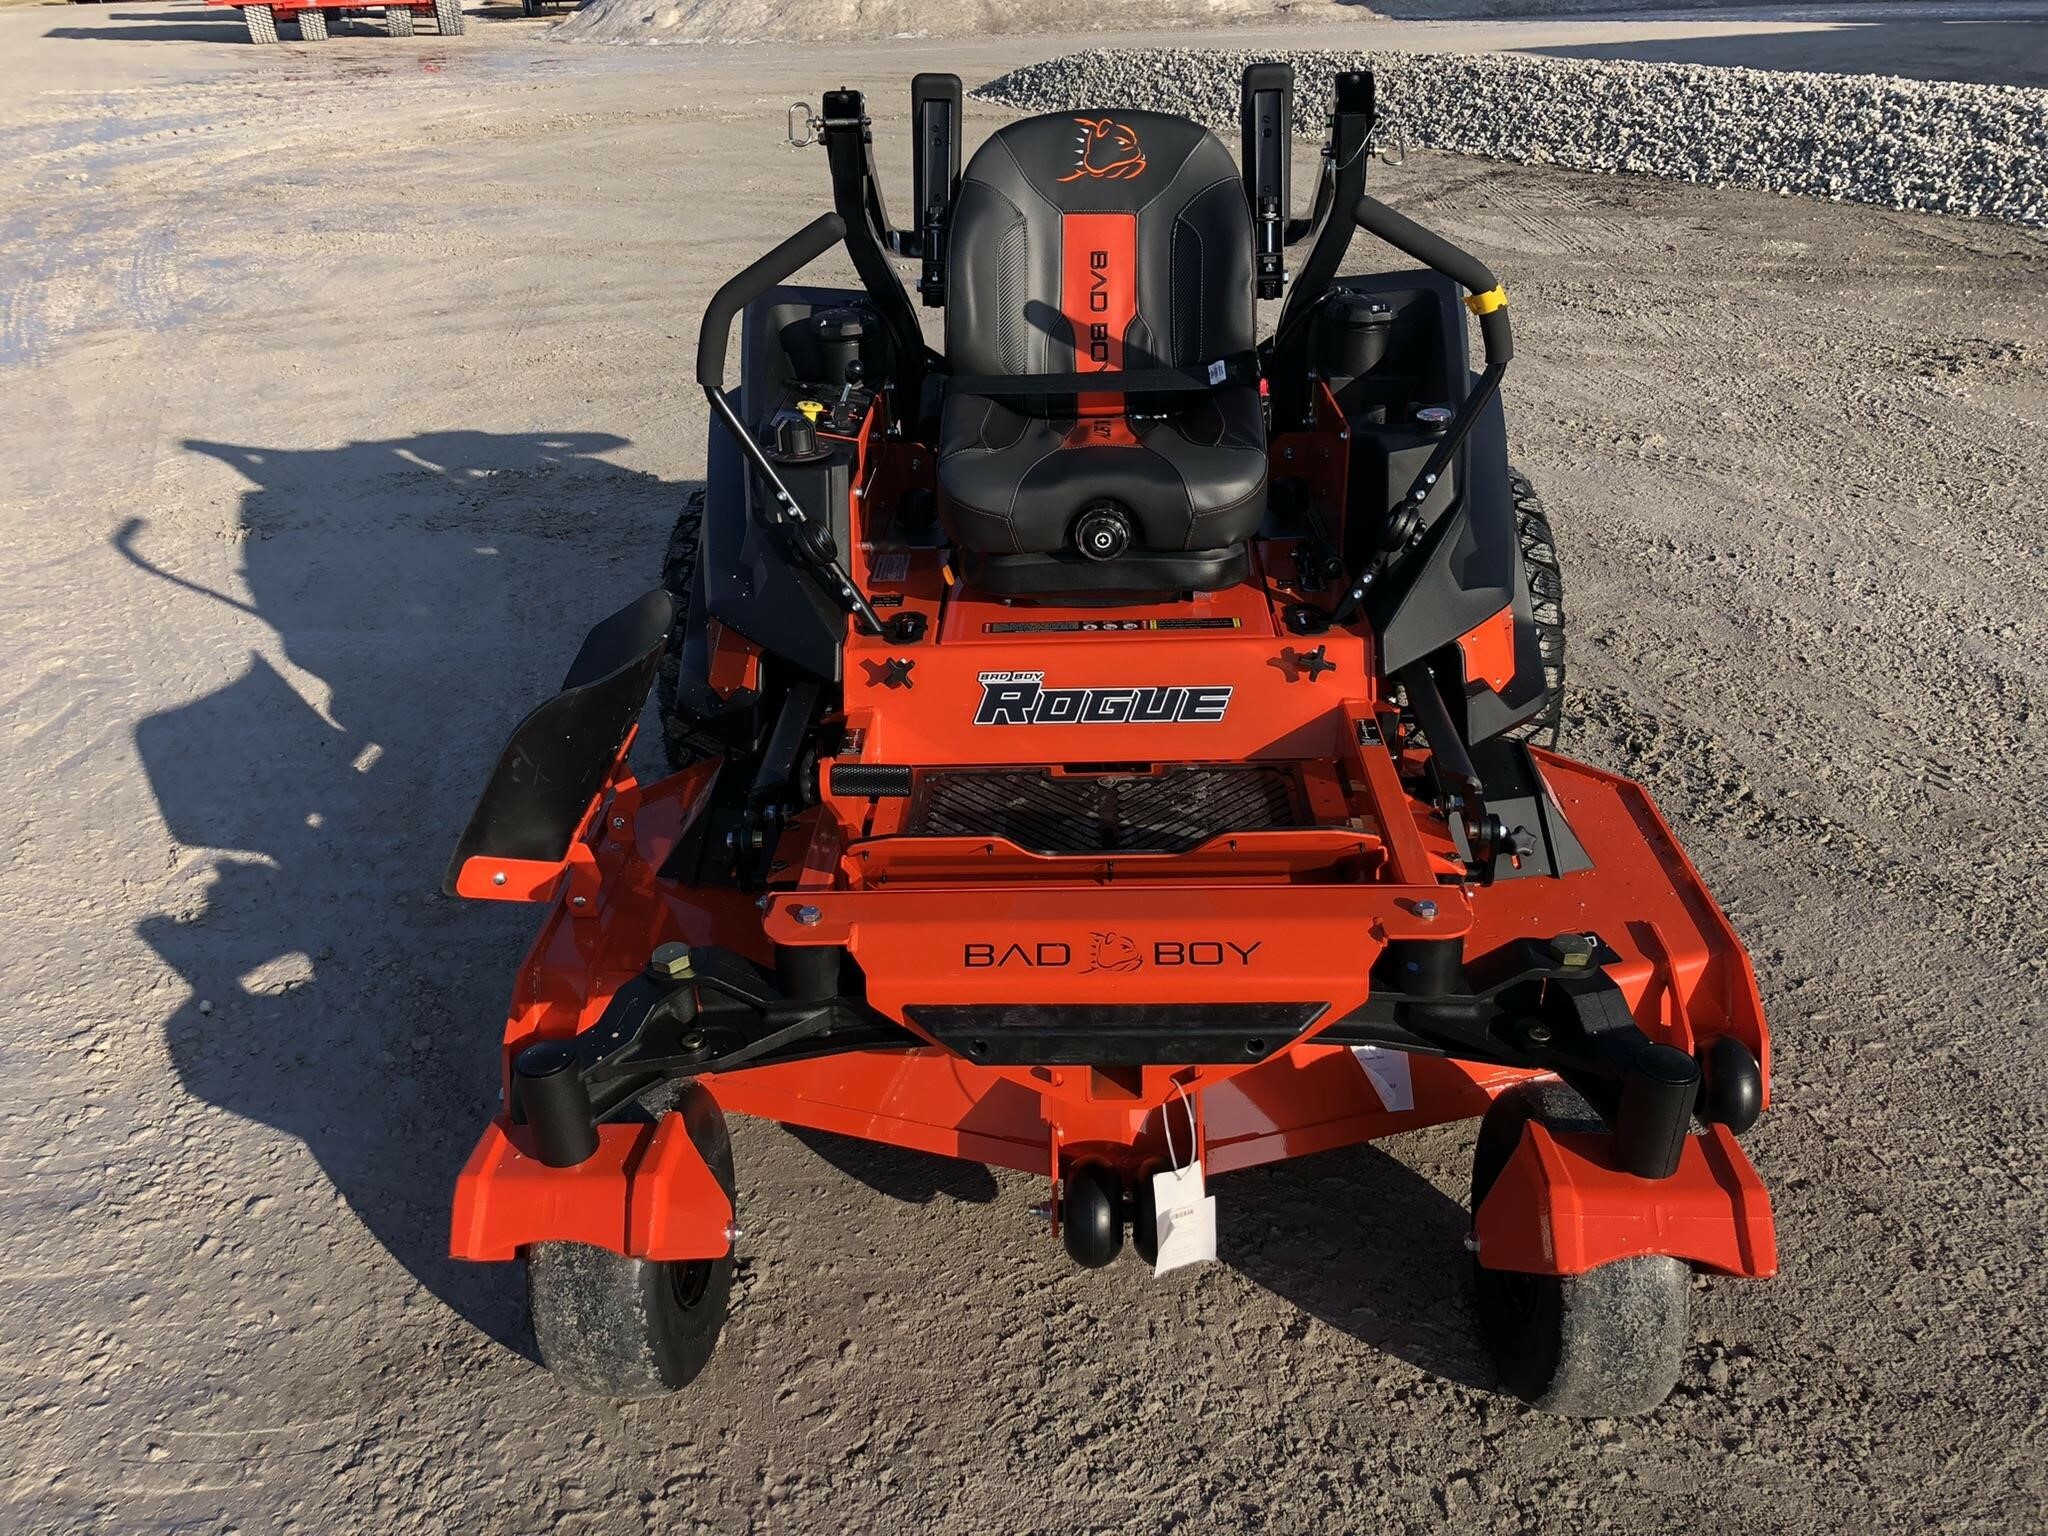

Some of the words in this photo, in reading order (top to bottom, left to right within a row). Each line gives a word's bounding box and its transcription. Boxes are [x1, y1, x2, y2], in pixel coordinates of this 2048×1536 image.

[1090, 250, 1107, 312] BAD
[979, 673, 1010, 682] BAD
[1012, 672, 1044, 681] BOY
[964, 943, 1071, 967] BAD
[1154, 941, 1262, 966] BOY
